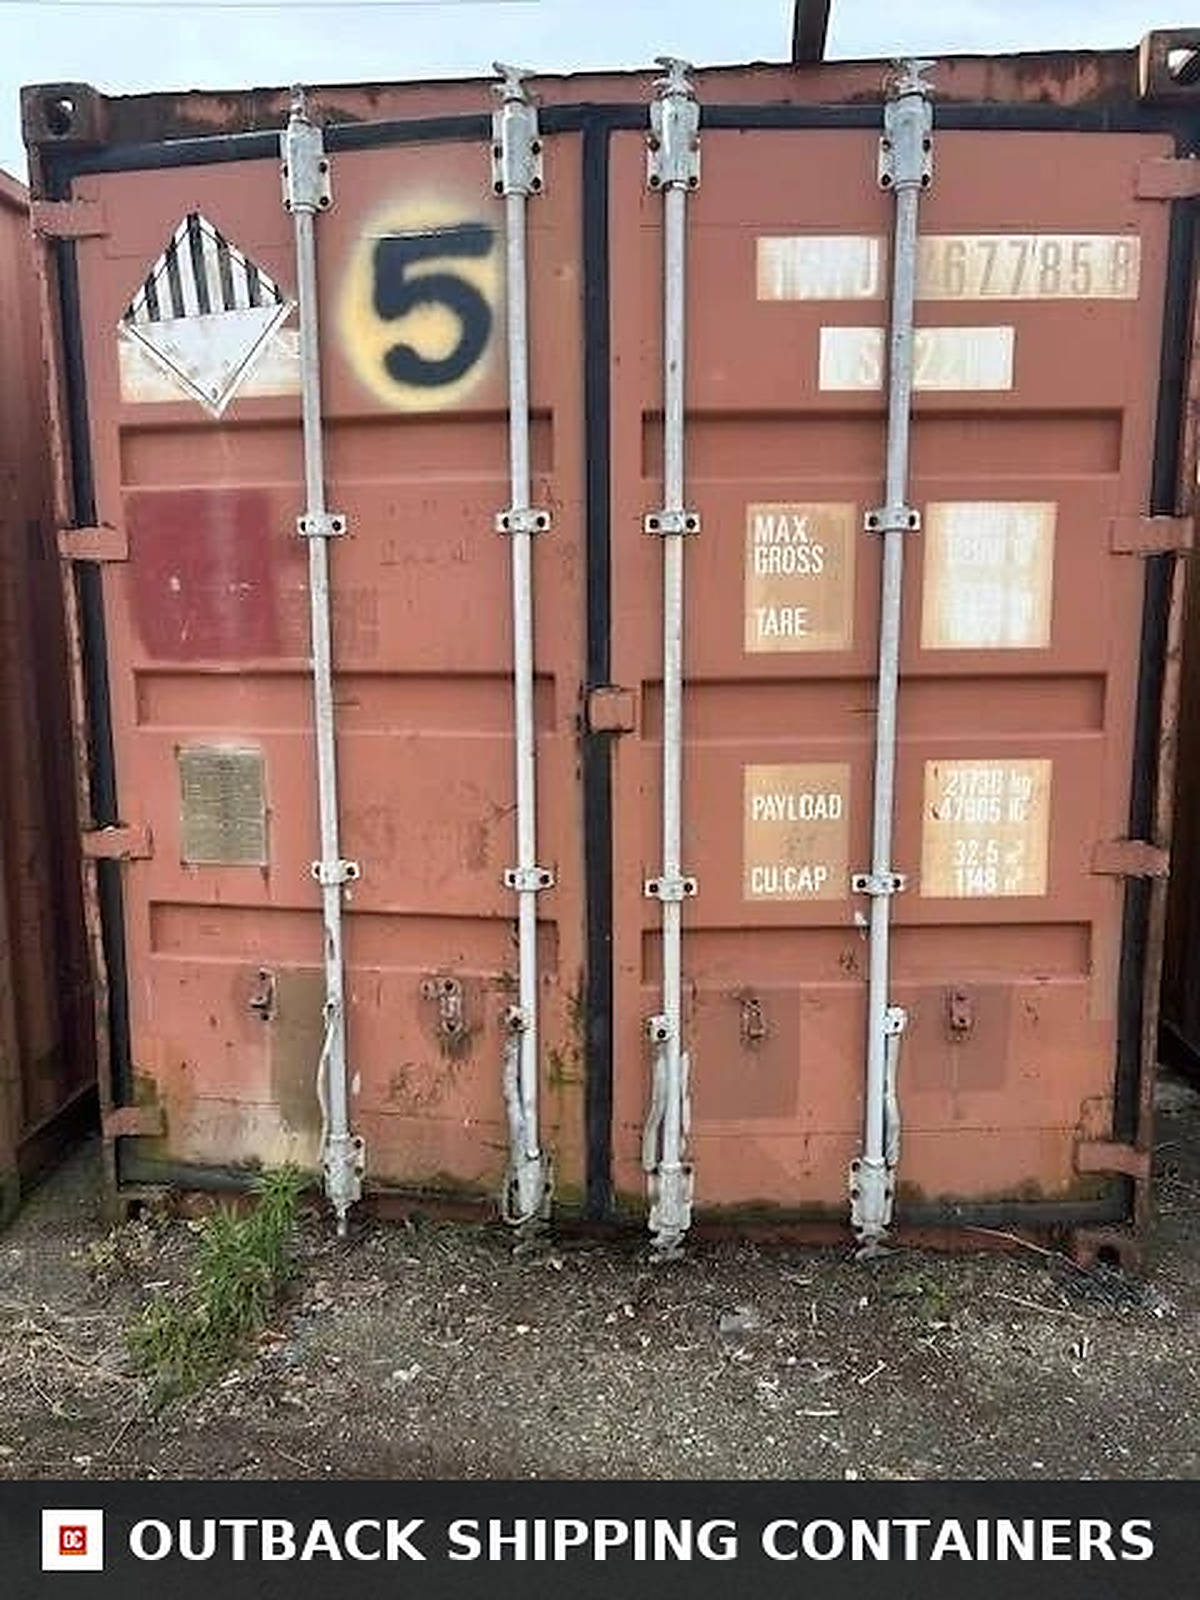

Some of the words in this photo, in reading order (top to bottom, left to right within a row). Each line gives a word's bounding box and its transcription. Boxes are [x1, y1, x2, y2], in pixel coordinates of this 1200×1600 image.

[373, 222, 496, 388] 5
[754, 545, 824, 575] GROSS
[755, 607, 808, 638] TARE
[751, 793, 843, 821] PAYLOAD
[751, 866, 827, 894] CU.CAP
